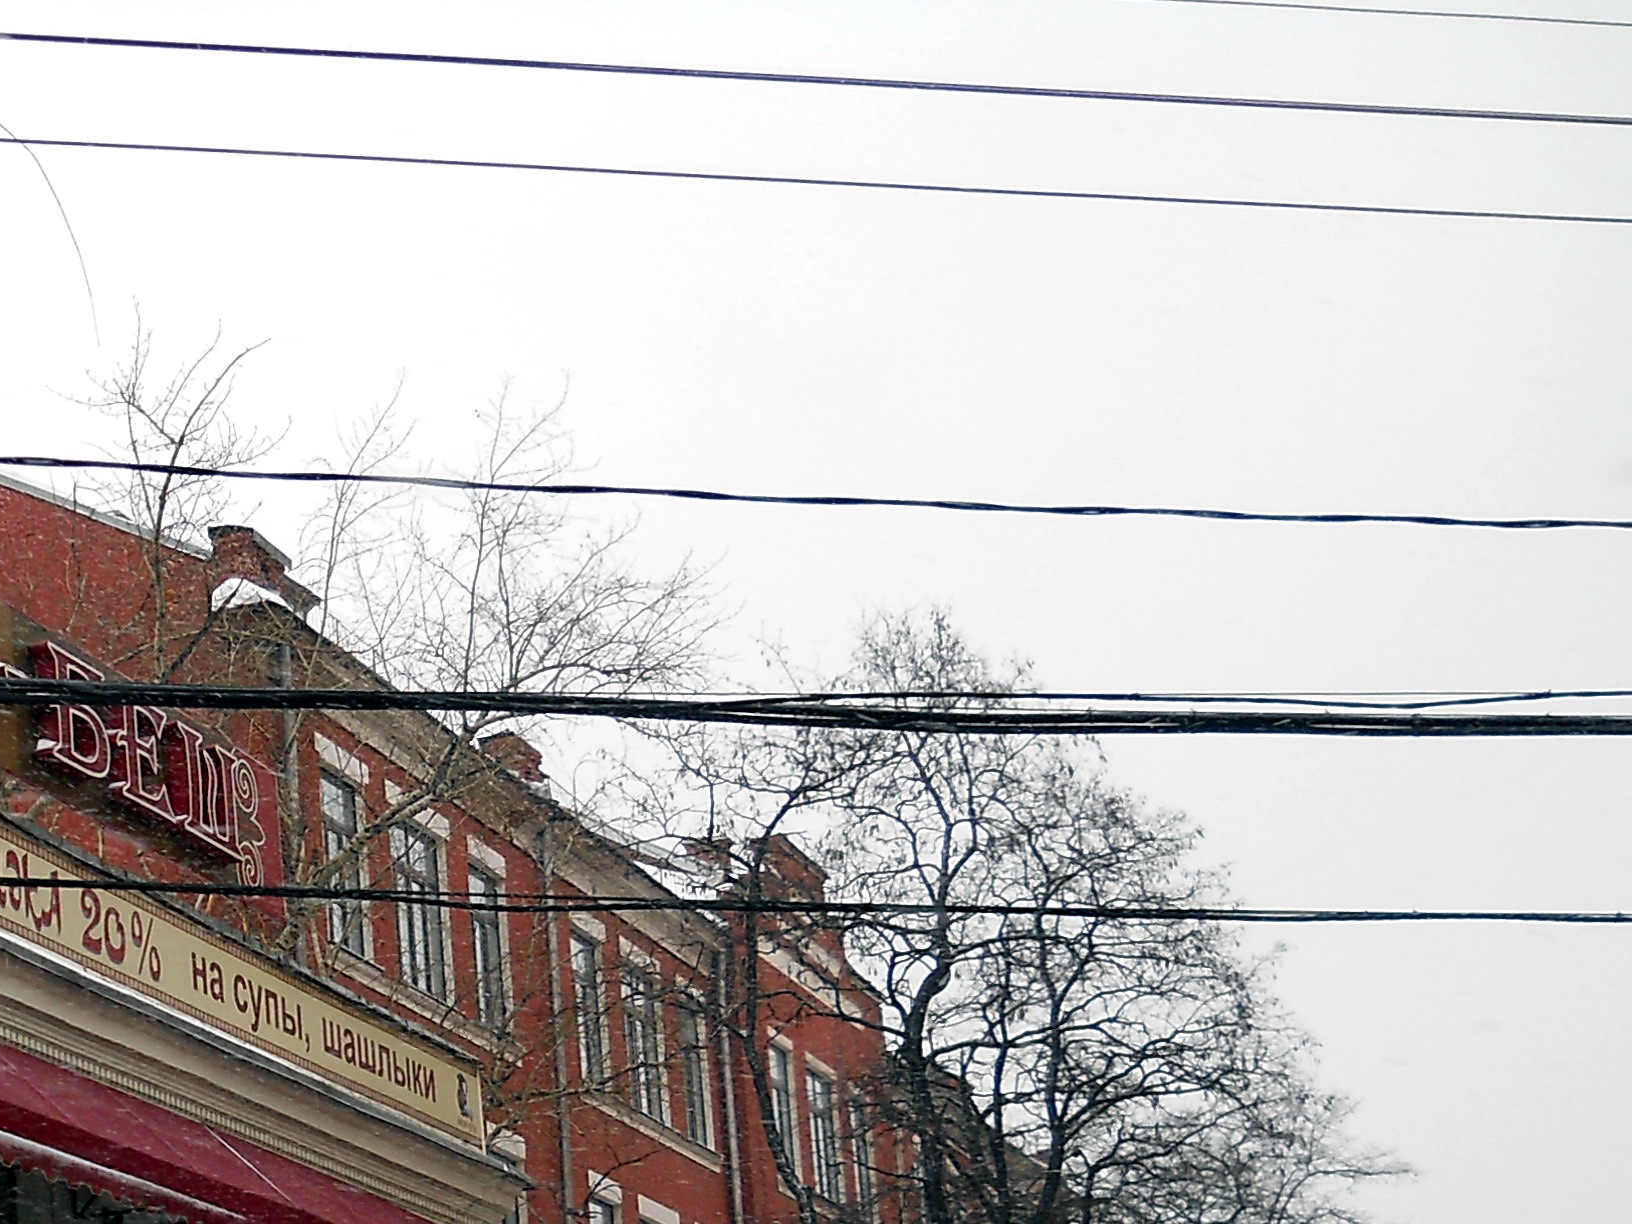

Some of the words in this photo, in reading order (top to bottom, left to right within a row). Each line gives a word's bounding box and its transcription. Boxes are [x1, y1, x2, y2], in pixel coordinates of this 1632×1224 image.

[79, 886, 162, 983] 20%
[190, 951, 226, 1004] на
[233, 972, 312, 1054] супы,
[322, 1015, 438, 1104] шашлыки
